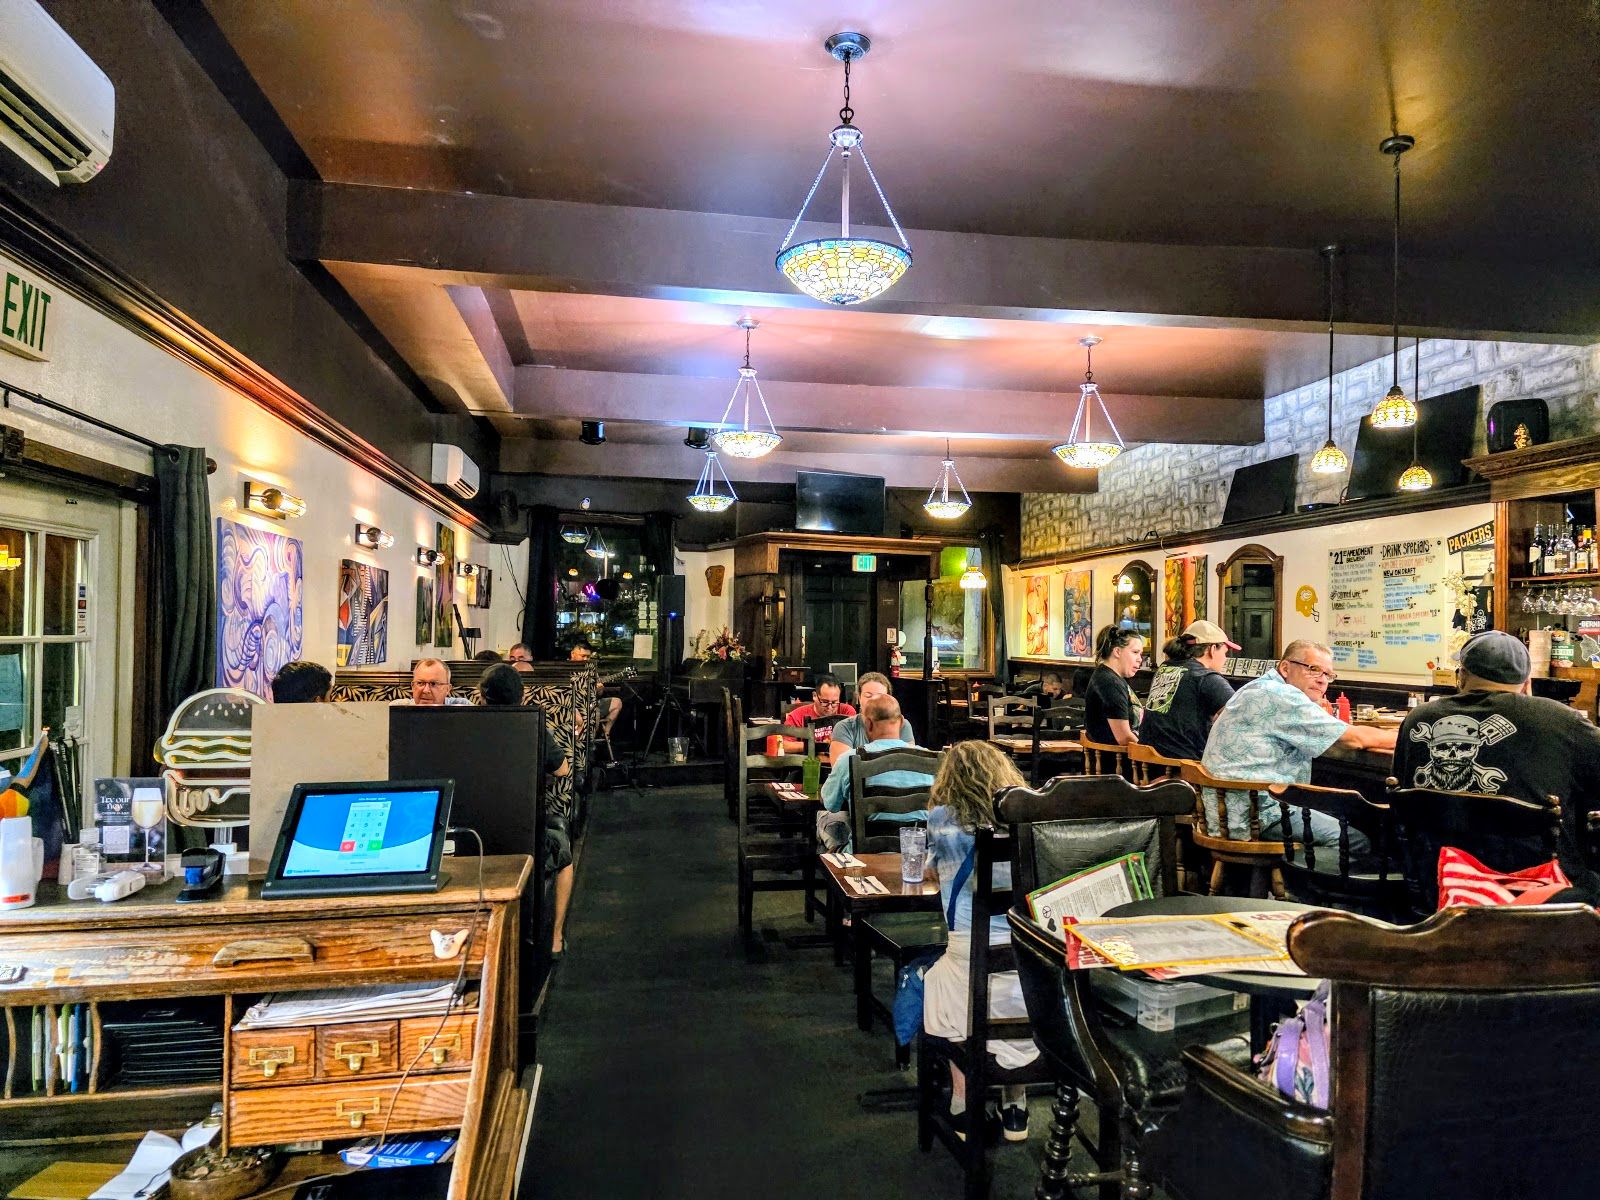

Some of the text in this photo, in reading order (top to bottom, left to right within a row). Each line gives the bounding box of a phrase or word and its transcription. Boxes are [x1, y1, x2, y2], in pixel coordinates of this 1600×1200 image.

[1, 272, 51, 353] EXIT
[1448, 525, 1492, 553] PACKERS
[1347, 546, 1374, 557] AMENDMENT
[100, 796, 130, 804] Try our
[106, 802, 123, 810] new
